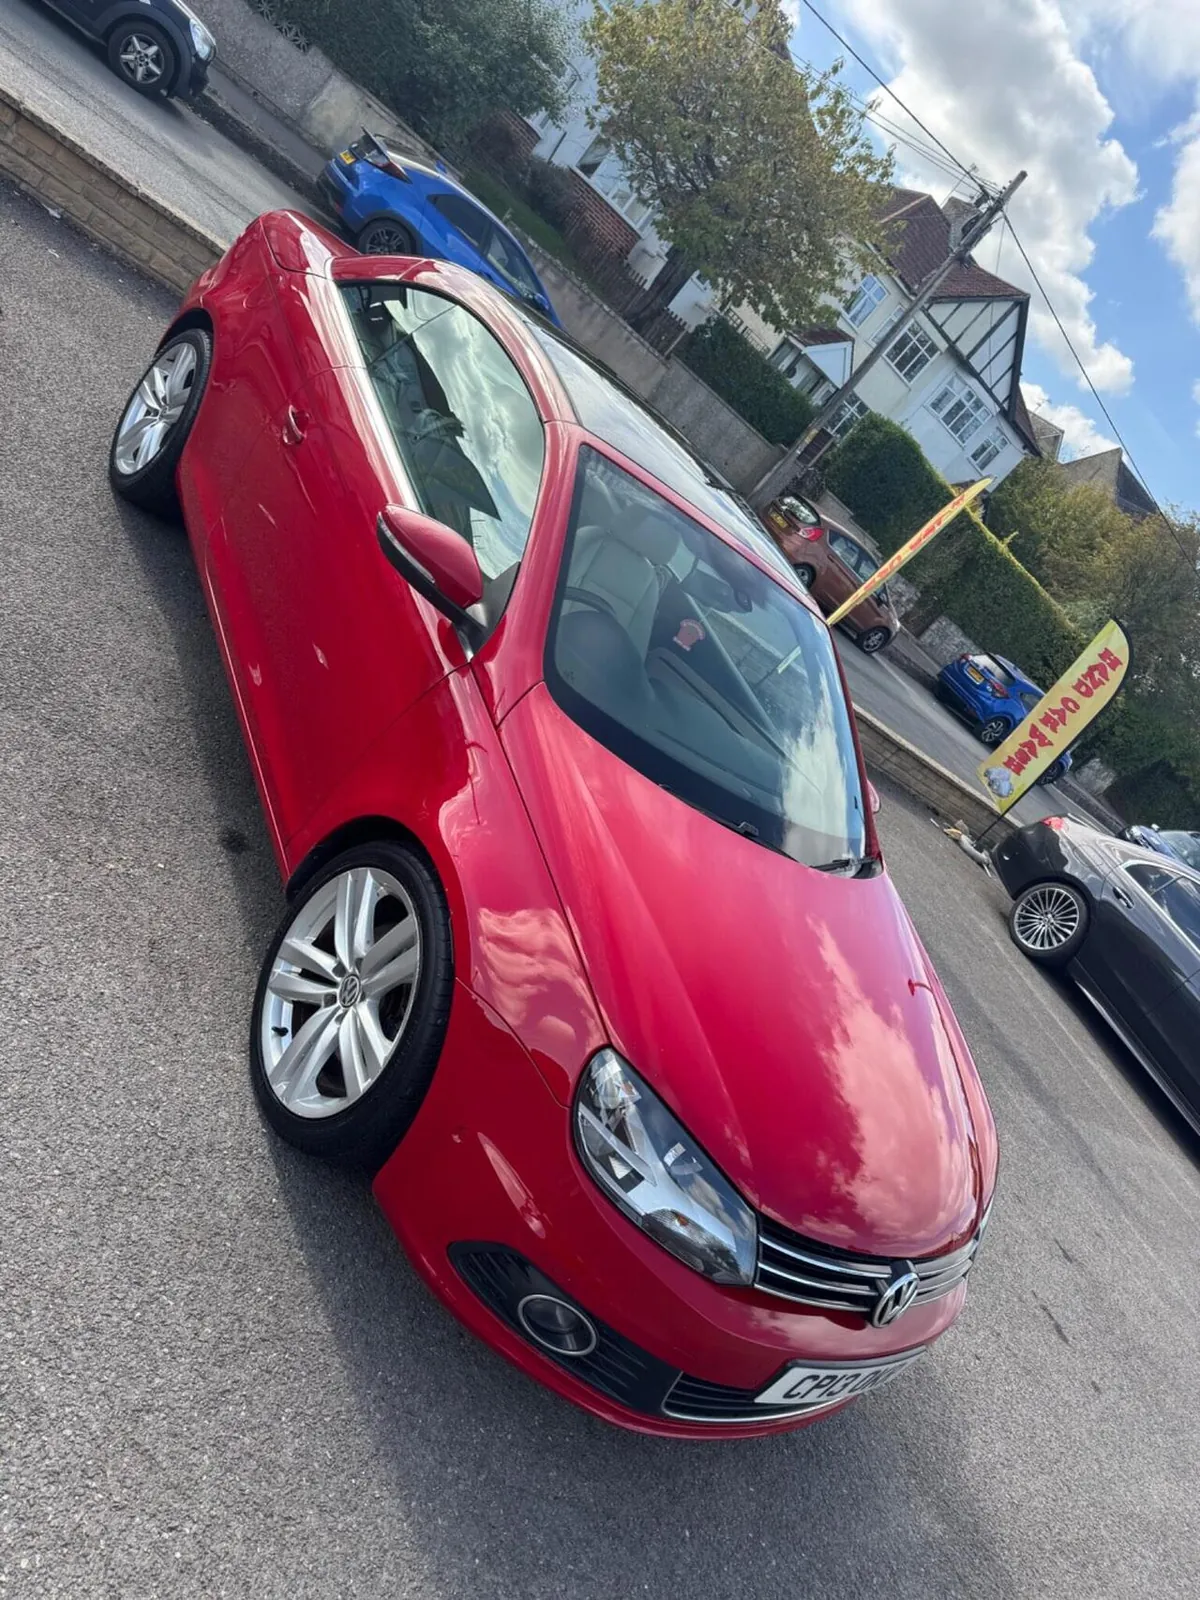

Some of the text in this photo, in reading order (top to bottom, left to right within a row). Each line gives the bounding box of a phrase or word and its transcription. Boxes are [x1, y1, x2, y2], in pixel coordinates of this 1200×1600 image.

[1003, 647, 1123, 776] HAND CAR WASH
